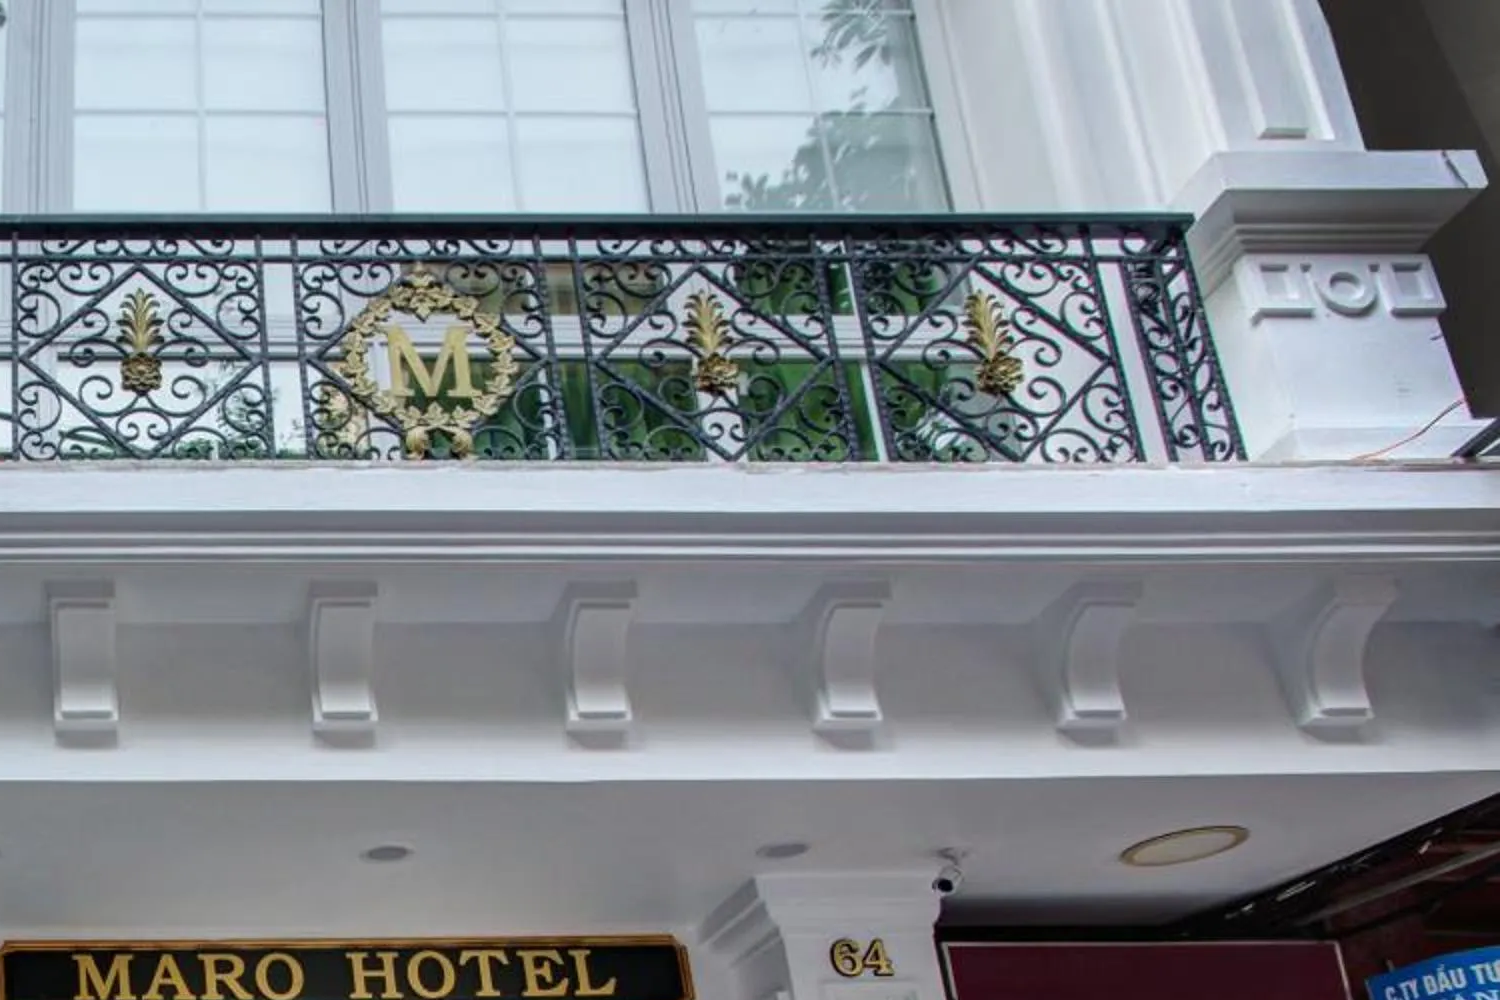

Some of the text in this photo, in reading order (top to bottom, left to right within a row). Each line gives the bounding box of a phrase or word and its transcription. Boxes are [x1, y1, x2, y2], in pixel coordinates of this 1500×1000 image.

[381, 325, 482, 397] M
[345, 949, 618, 1000] HOTEL
[829, 938, 895, 978] 64
